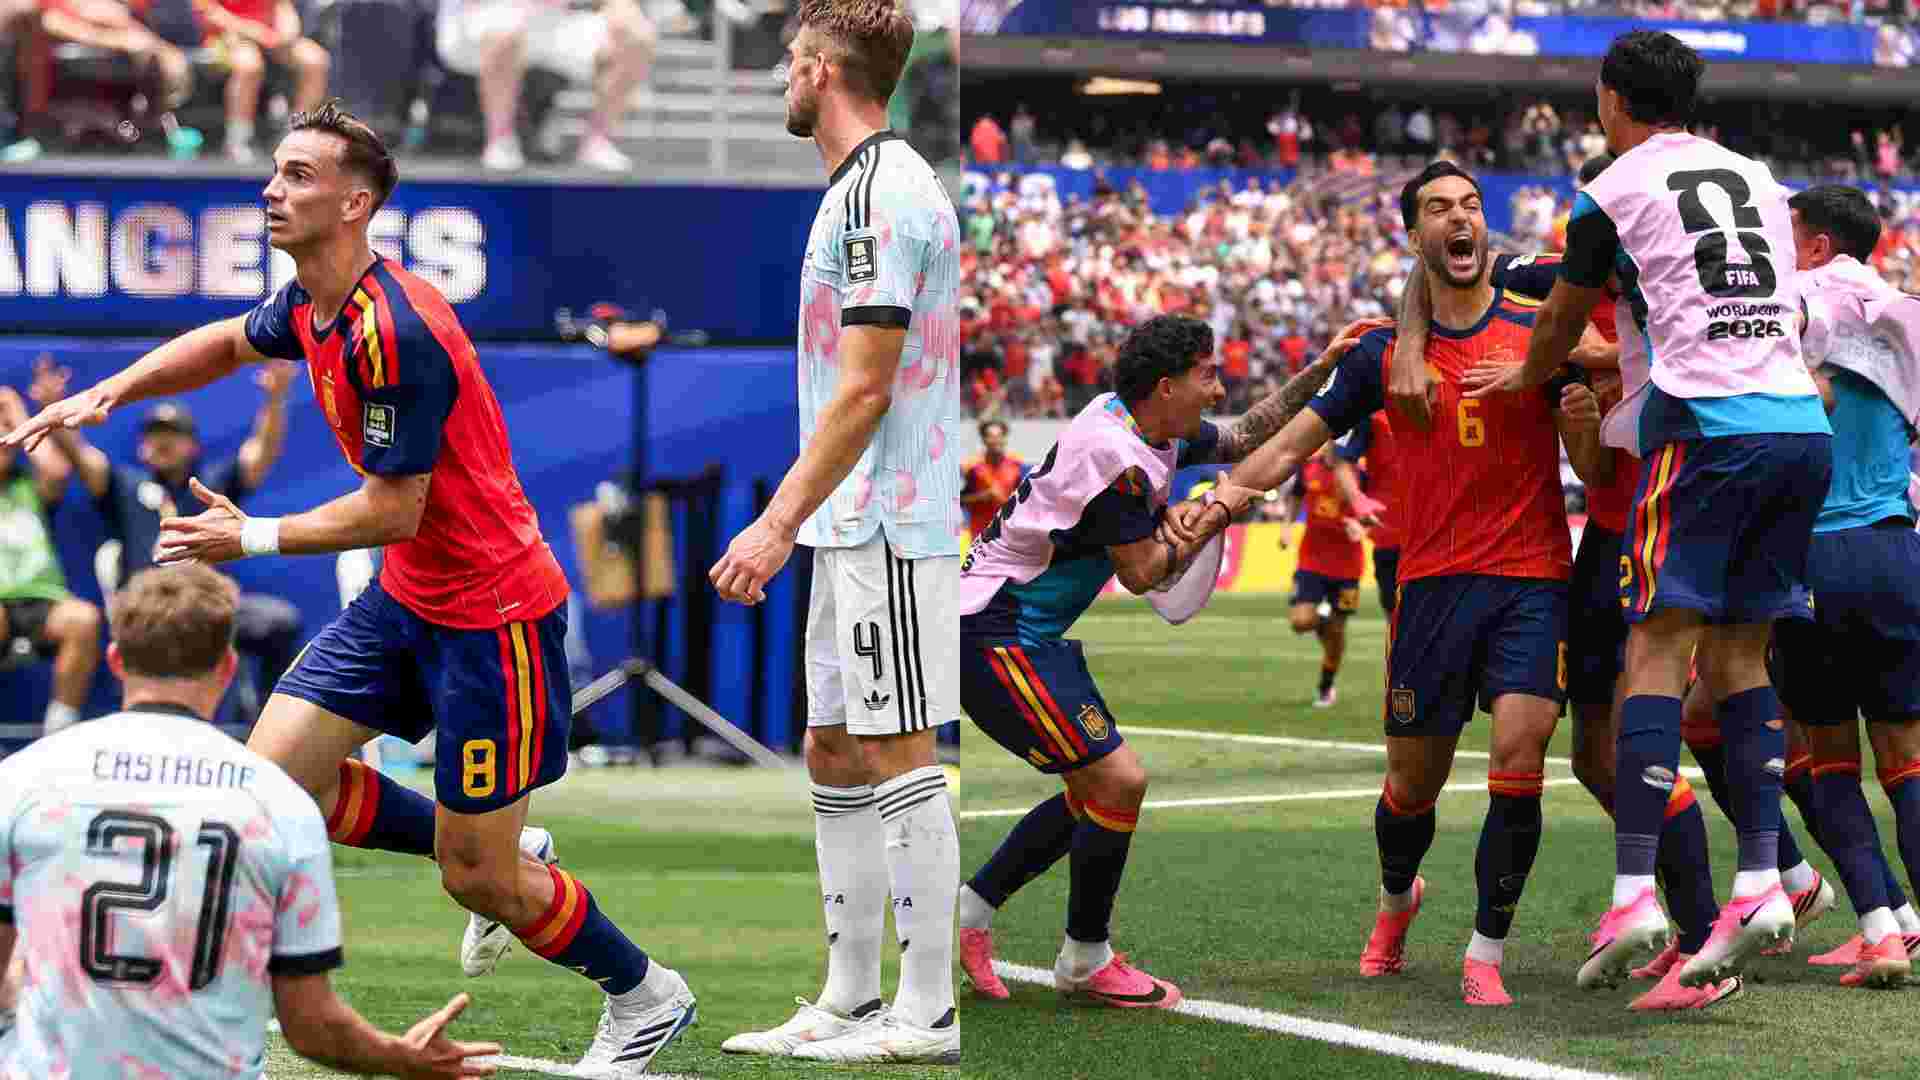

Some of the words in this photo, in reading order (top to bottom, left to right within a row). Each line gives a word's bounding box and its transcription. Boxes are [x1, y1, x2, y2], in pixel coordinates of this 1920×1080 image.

[1726, 270, 1760, 287] FIFA
[1706, 304, 1757, 319] WORLD
[1707, 319, 1784, 340] 2026
[1457, 398, 1484, 448] 6
[853, 621, 882, 680] 4
[463, 738, 497, 798] 8
[79, 810, 240, 991] 21
